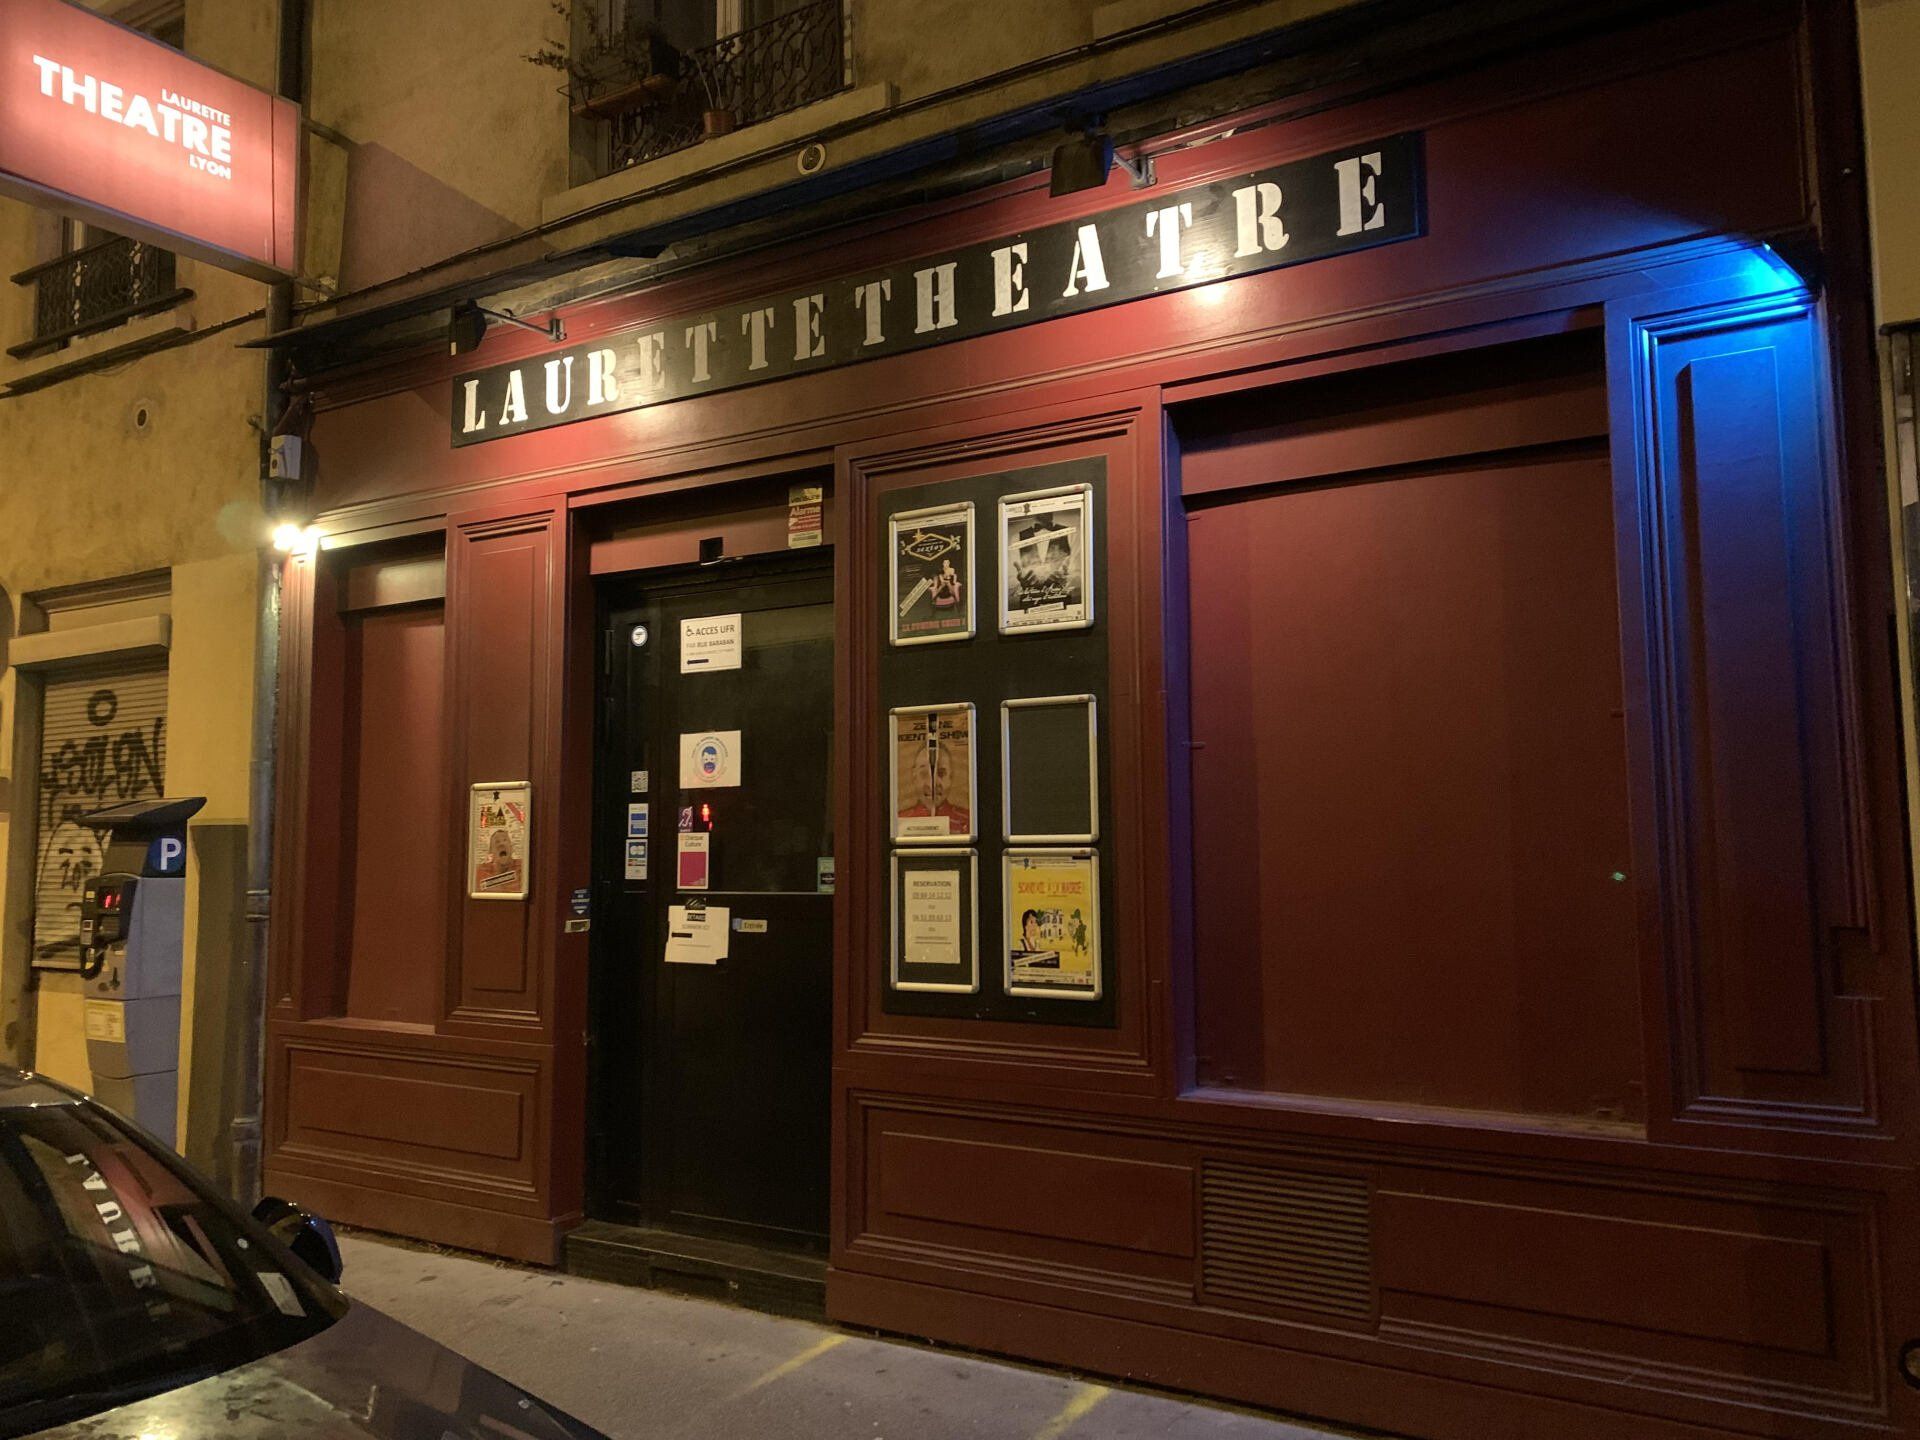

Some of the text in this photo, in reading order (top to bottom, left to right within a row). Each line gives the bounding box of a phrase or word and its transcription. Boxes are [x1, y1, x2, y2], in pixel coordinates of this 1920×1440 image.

[33, 54, 231, 164] THEATRE
[162, 88, 231, 127] LAURETTE
[189, 154, 231, 180] LYON
[463, 151, 1386, 434] LAURETTE THEATRE
[160, 837, 182, 871] P
